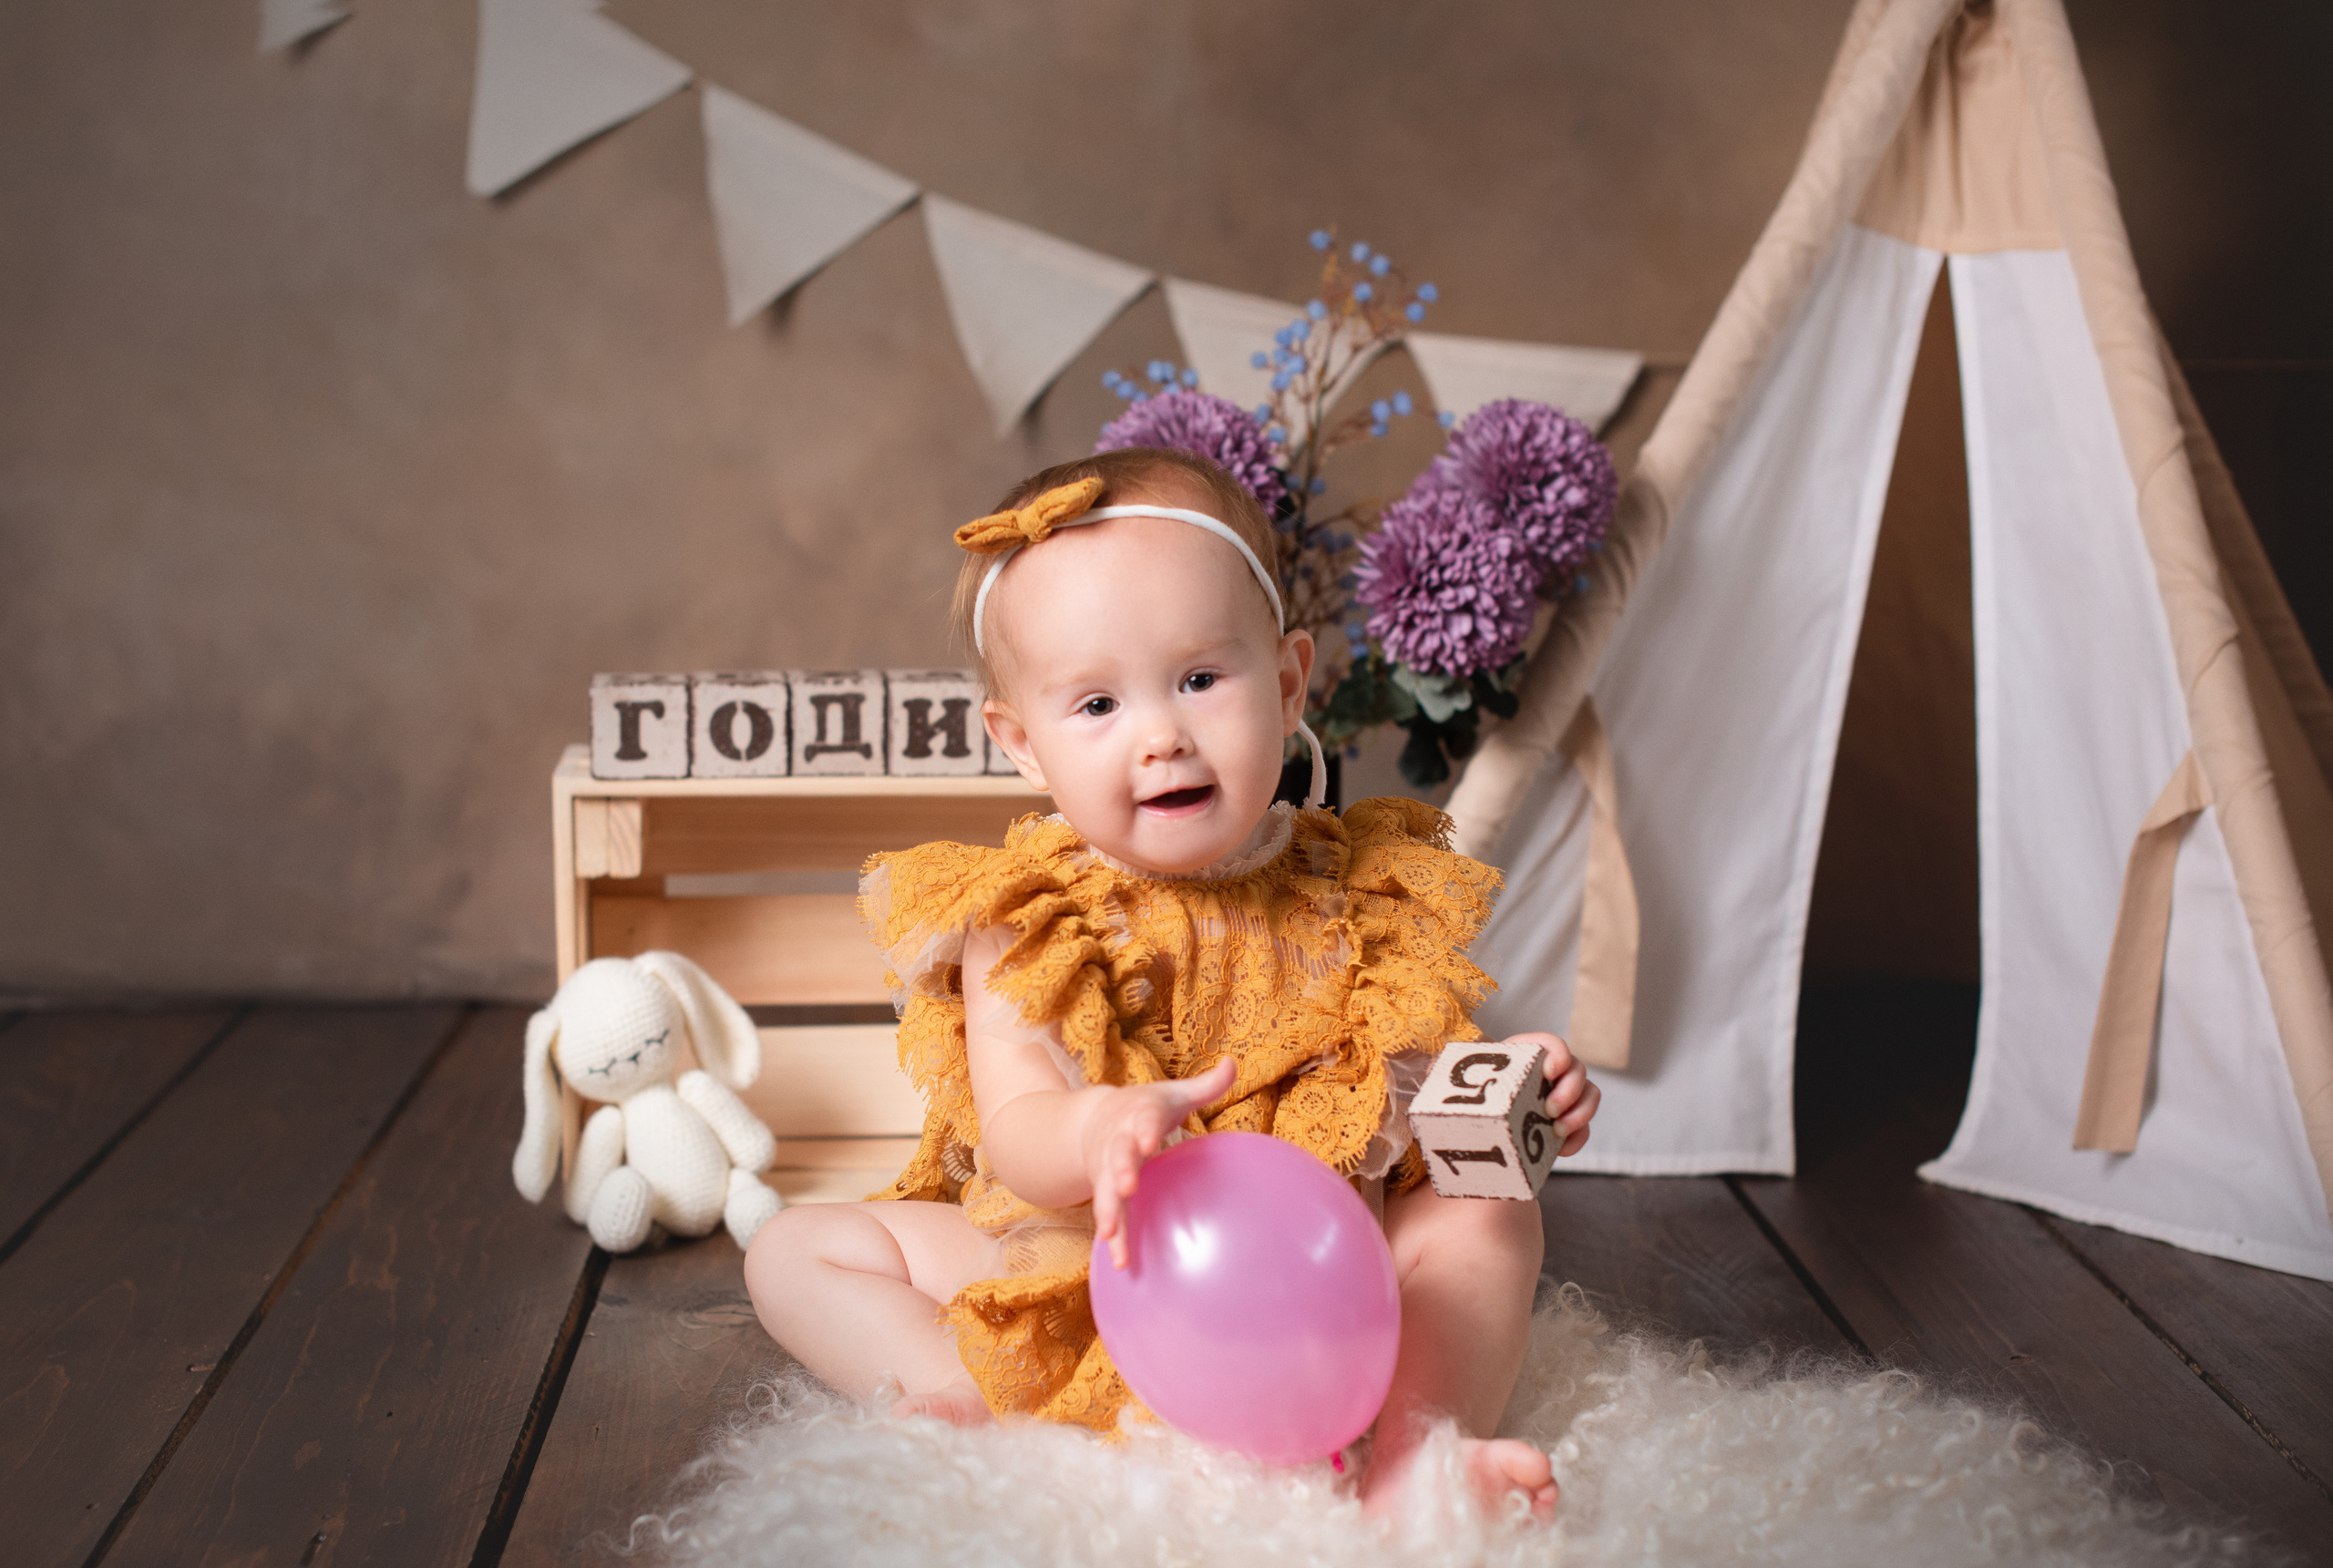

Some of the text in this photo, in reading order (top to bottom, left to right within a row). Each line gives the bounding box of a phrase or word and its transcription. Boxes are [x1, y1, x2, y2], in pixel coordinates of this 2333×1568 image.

[613, 693, 1010, 762] ГОДИ
[1443, 1053, 1511, 1104] 5
[1432, 1145, 1507, 1175] 1
